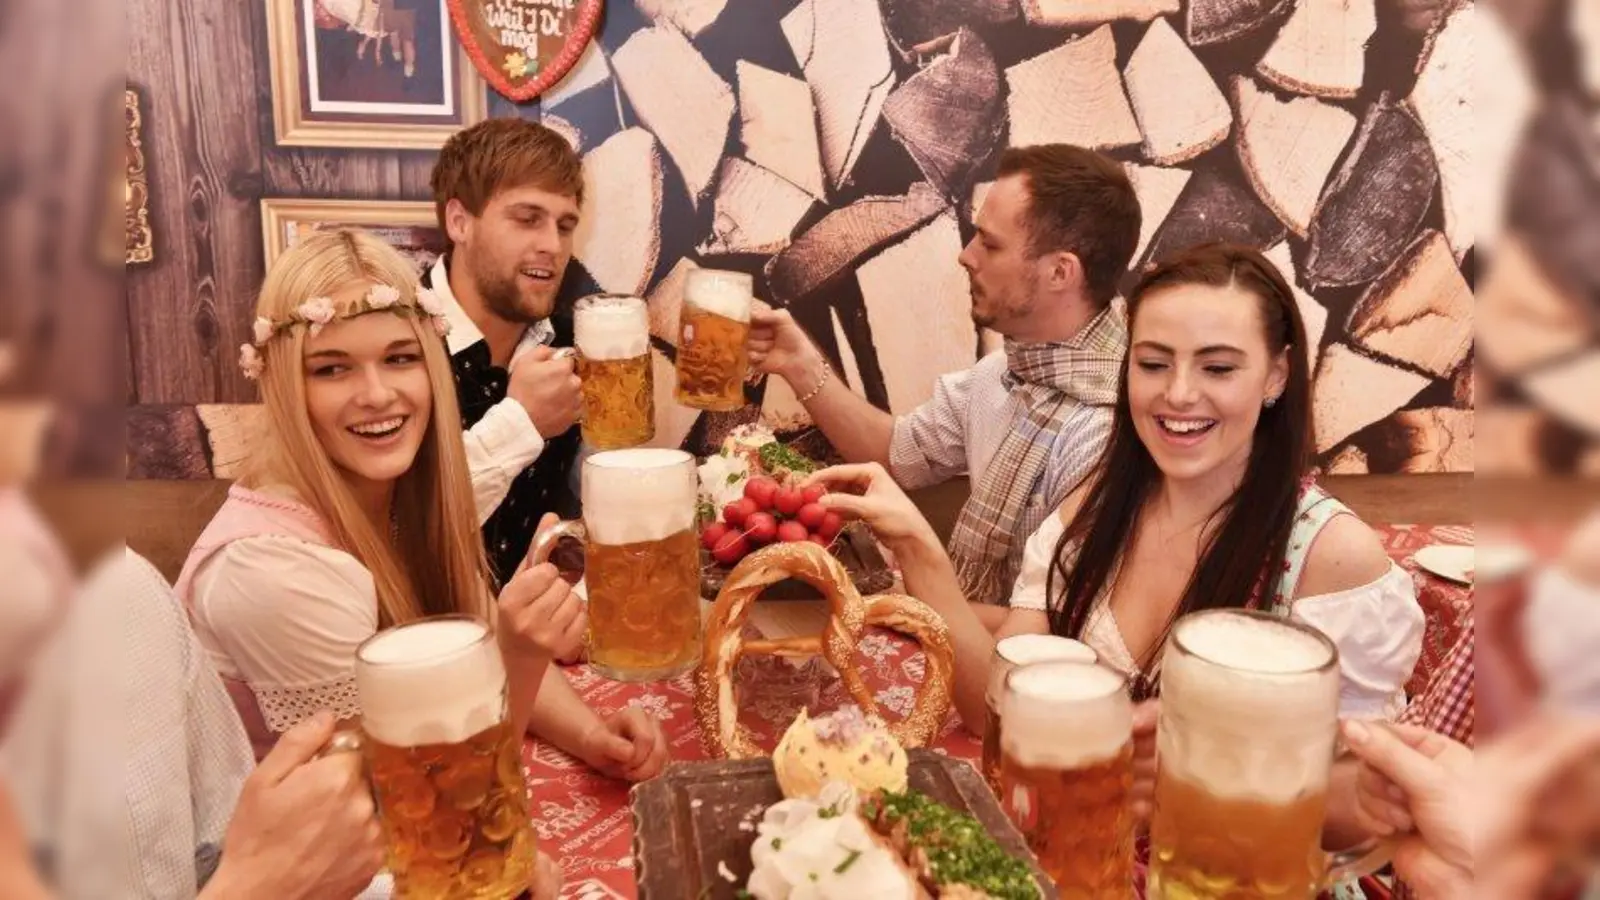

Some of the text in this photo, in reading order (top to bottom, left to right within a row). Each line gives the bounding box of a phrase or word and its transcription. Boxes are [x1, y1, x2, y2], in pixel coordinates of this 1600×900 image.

[486, 4, 524, 31] Weil
[540, 8, 564, 37] Di
[501, 30, 538, 59] mog
